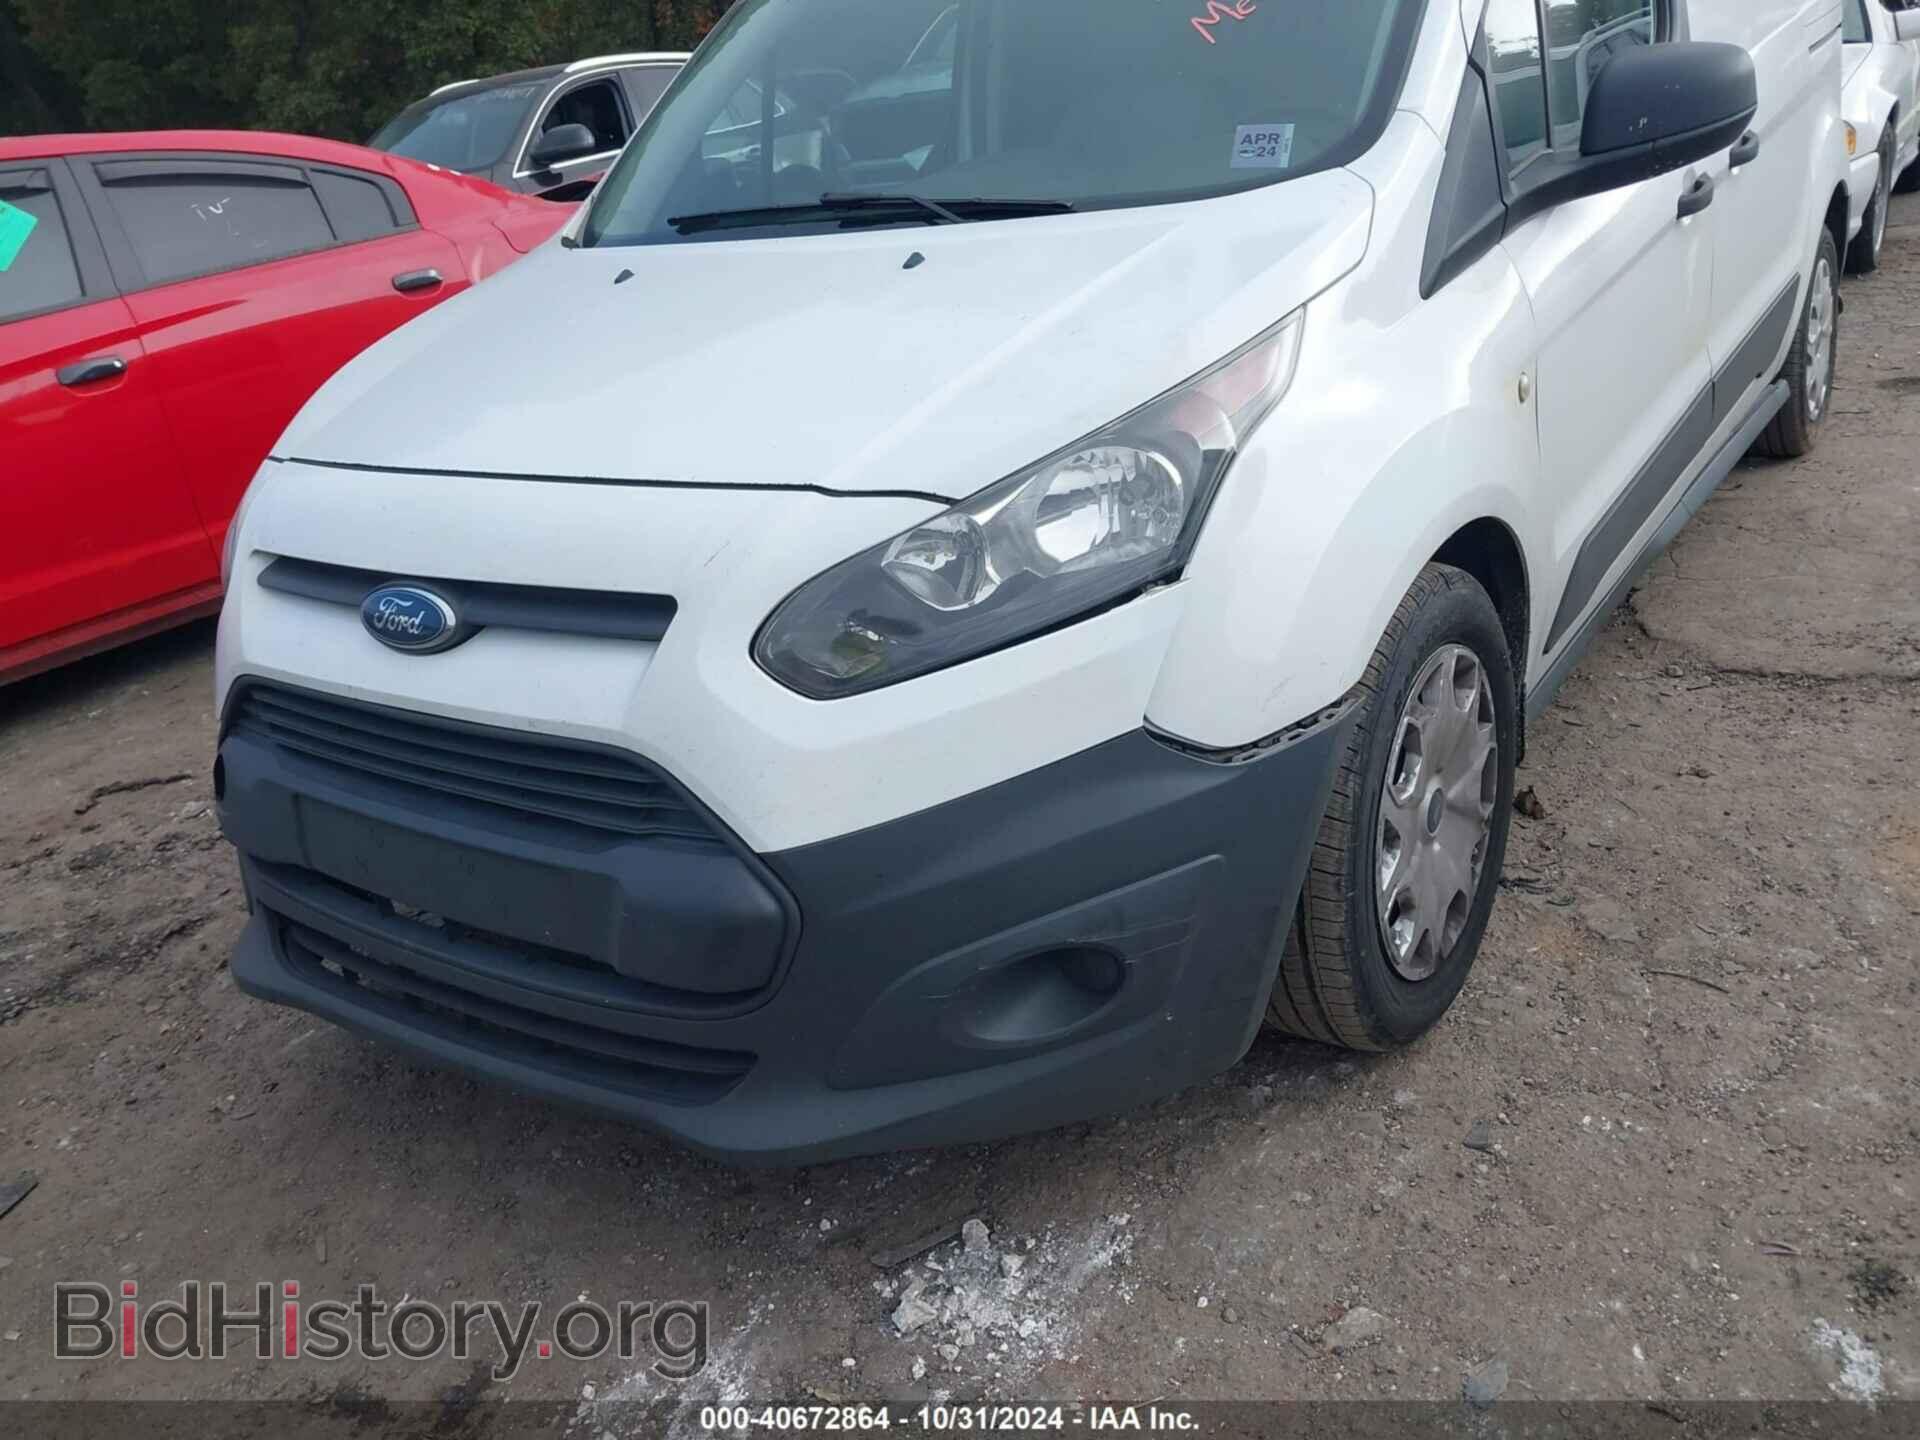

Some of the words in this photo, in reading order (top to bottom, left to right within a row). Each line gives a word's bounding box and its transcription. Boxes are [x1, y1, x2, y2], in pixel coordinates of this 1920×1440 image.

[1240, 132, 1280, 145] APR
[1256, 146, 1277, 157] 24
[374, 597, 425, 635] Ford
